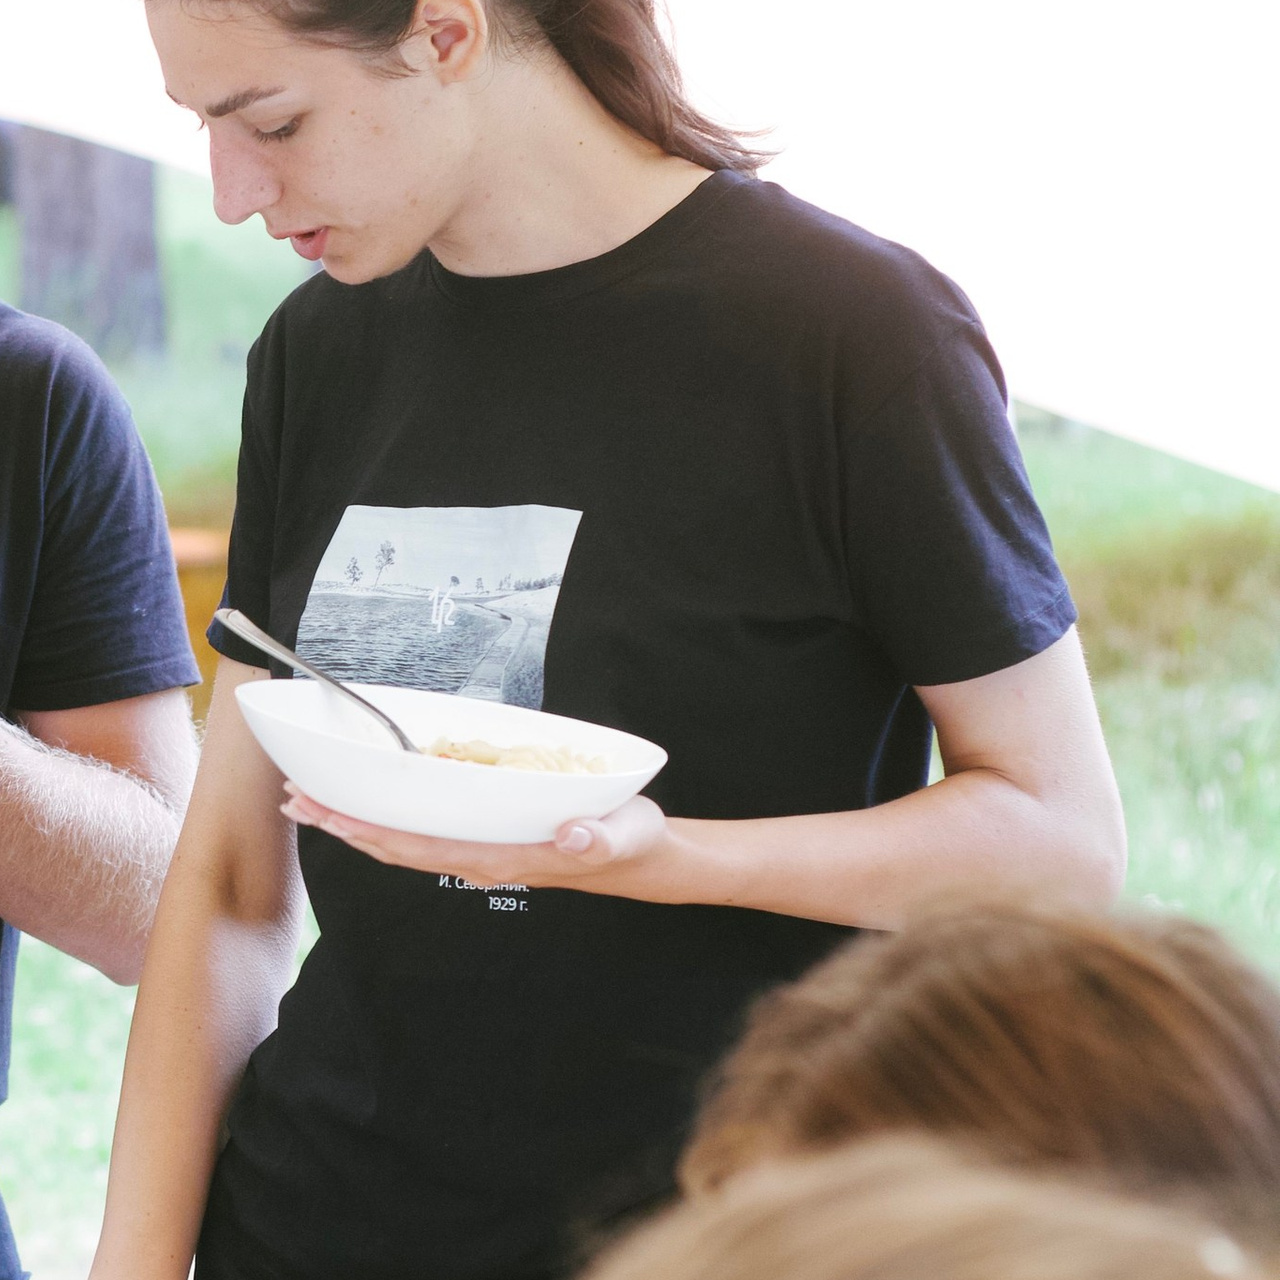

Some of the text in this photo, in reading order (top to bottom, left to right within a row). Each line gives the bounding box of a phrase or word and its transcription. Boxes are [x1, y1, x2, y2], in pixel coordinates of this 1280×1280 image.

[438, 874, 452, 888] И.
[488, 896, 529, 912] 1929 г.
